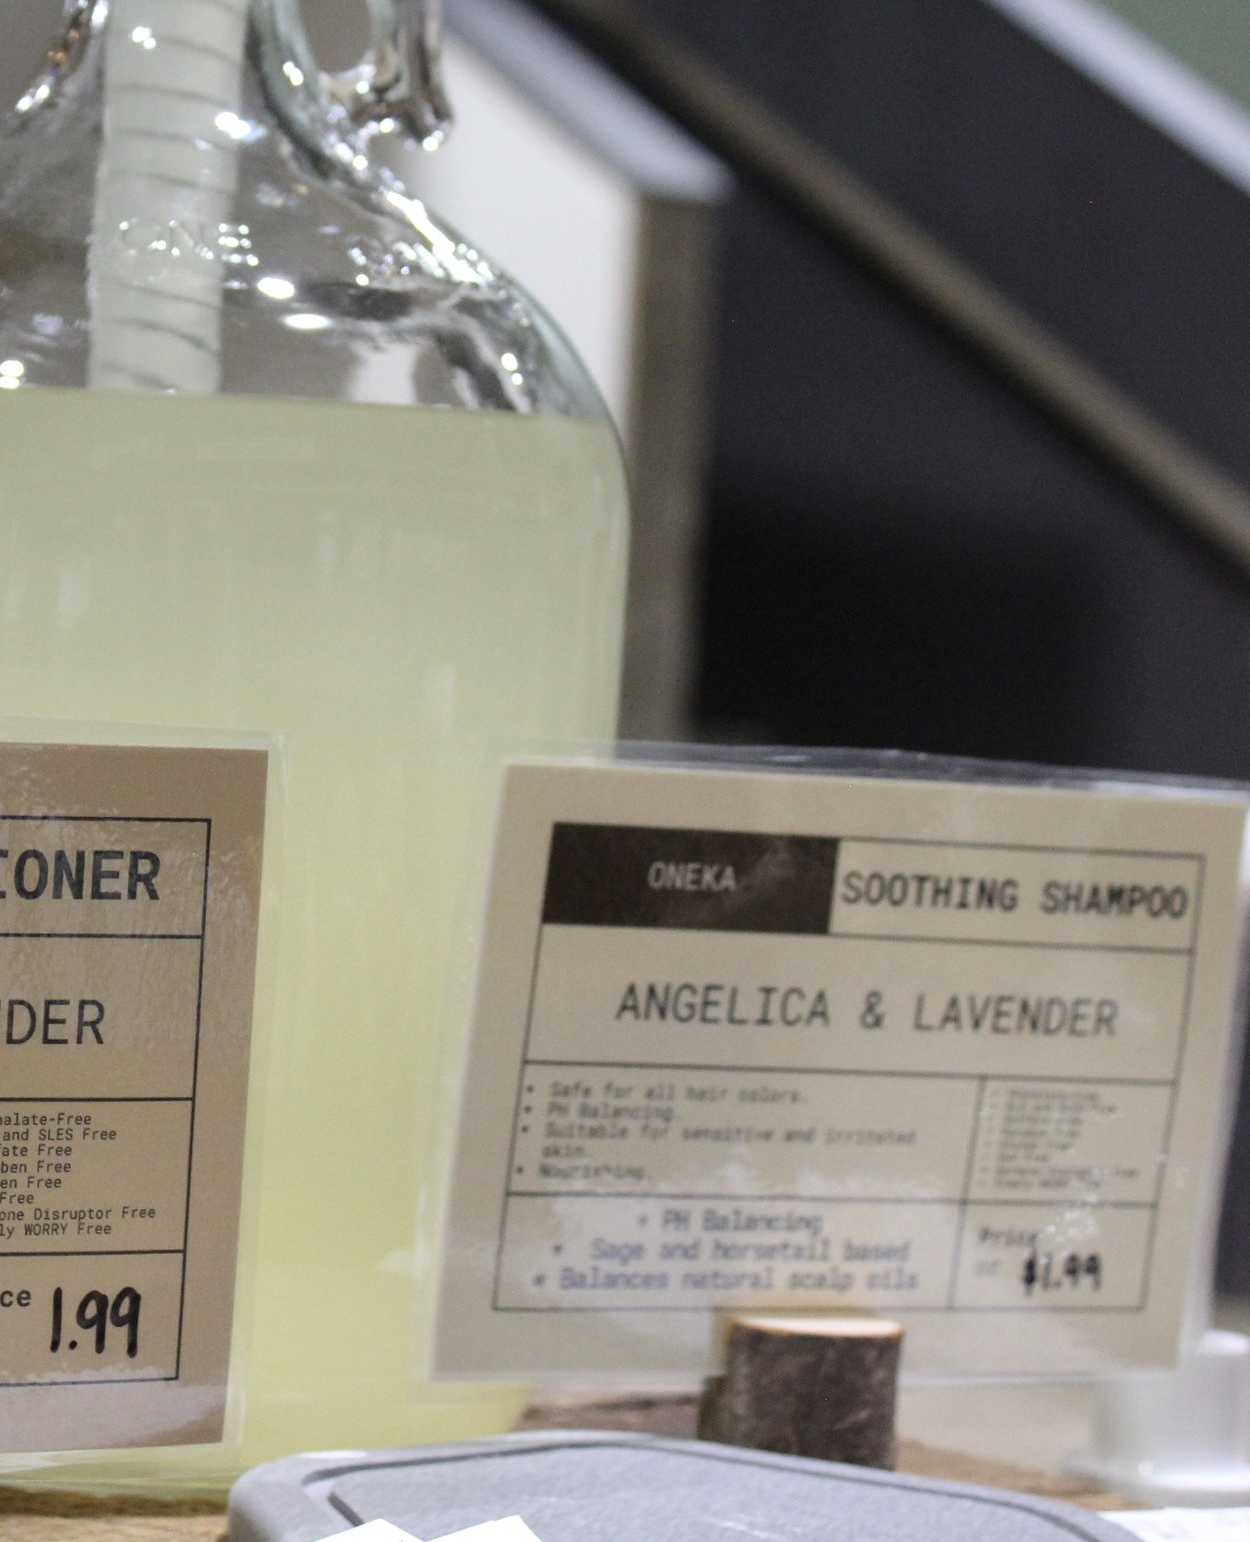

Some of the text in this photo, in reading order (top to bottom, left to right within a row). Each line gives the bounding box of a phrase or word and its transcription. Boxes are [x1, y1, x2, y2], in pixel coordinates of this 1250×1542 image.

[648, 861, 738, 893] ONEKA
[840, 871, 1190, 922] SOOTHING SHAMPOO
[615, 983, 1119, 1037] ANGELICA & LAVENDER
[2, 1128, 30, 1142] and
[38, 1127, 74, 1141] SLES
[82, 1127, 117, 1141] Free
[37, 1143, 73, 1157] Free
[36, 1159, 72, 1173] Free
[27, 1175, 62, 1189] Free
[33, 1207, 112, 1223] Disruptor
[121, 1205, 156, 1219] Free
[663, 1208, 823, 1237] PH Balancing
[24, 1222, 68, 1236] WORRY
[77, 1222, 112, 1235] Free
[591, 1237, 646, 1268] Sage
[658, 1240, 701, 1261] and
[711, 1239, 831, 1262] horsetail
[559, 1267, 669, 1290] Balances
[681, 1269, 774, 1291] natural
[49, 1286, 142, 1359] 1.99
